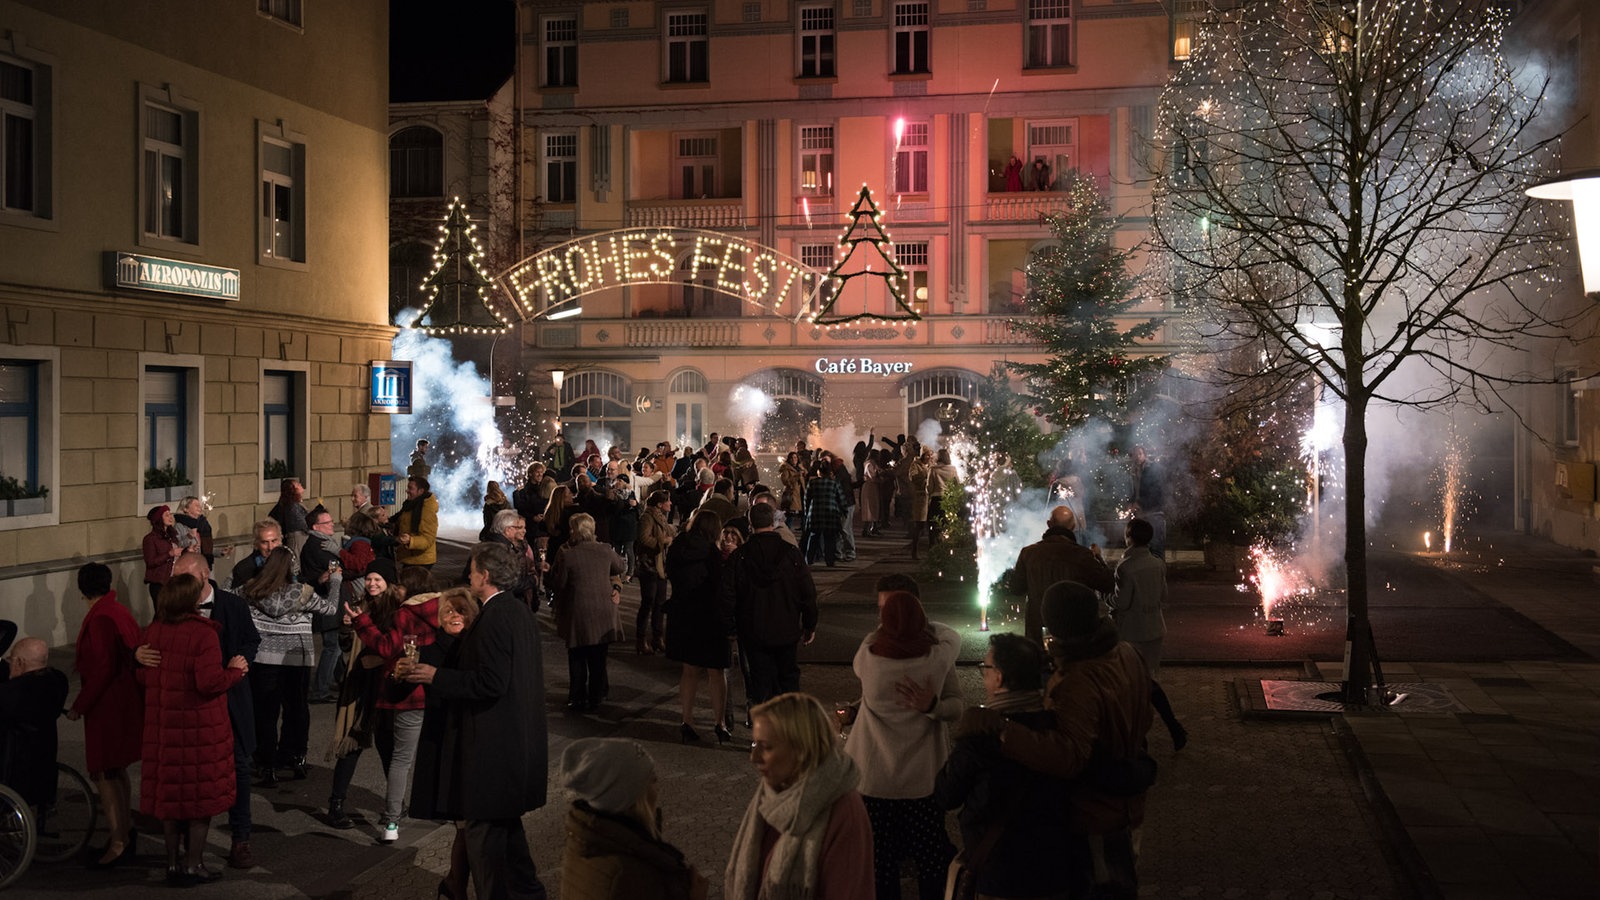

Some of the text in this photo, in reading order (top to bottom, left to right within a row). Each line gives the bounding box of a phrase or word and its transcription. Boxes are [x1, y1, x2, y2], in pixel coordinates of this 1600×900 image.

[140, 262, 222, 291] AKROPOLIS
[509, 232, 811, 312] FROHES FEST
[815, 358, 913, 376] Café Bayer
